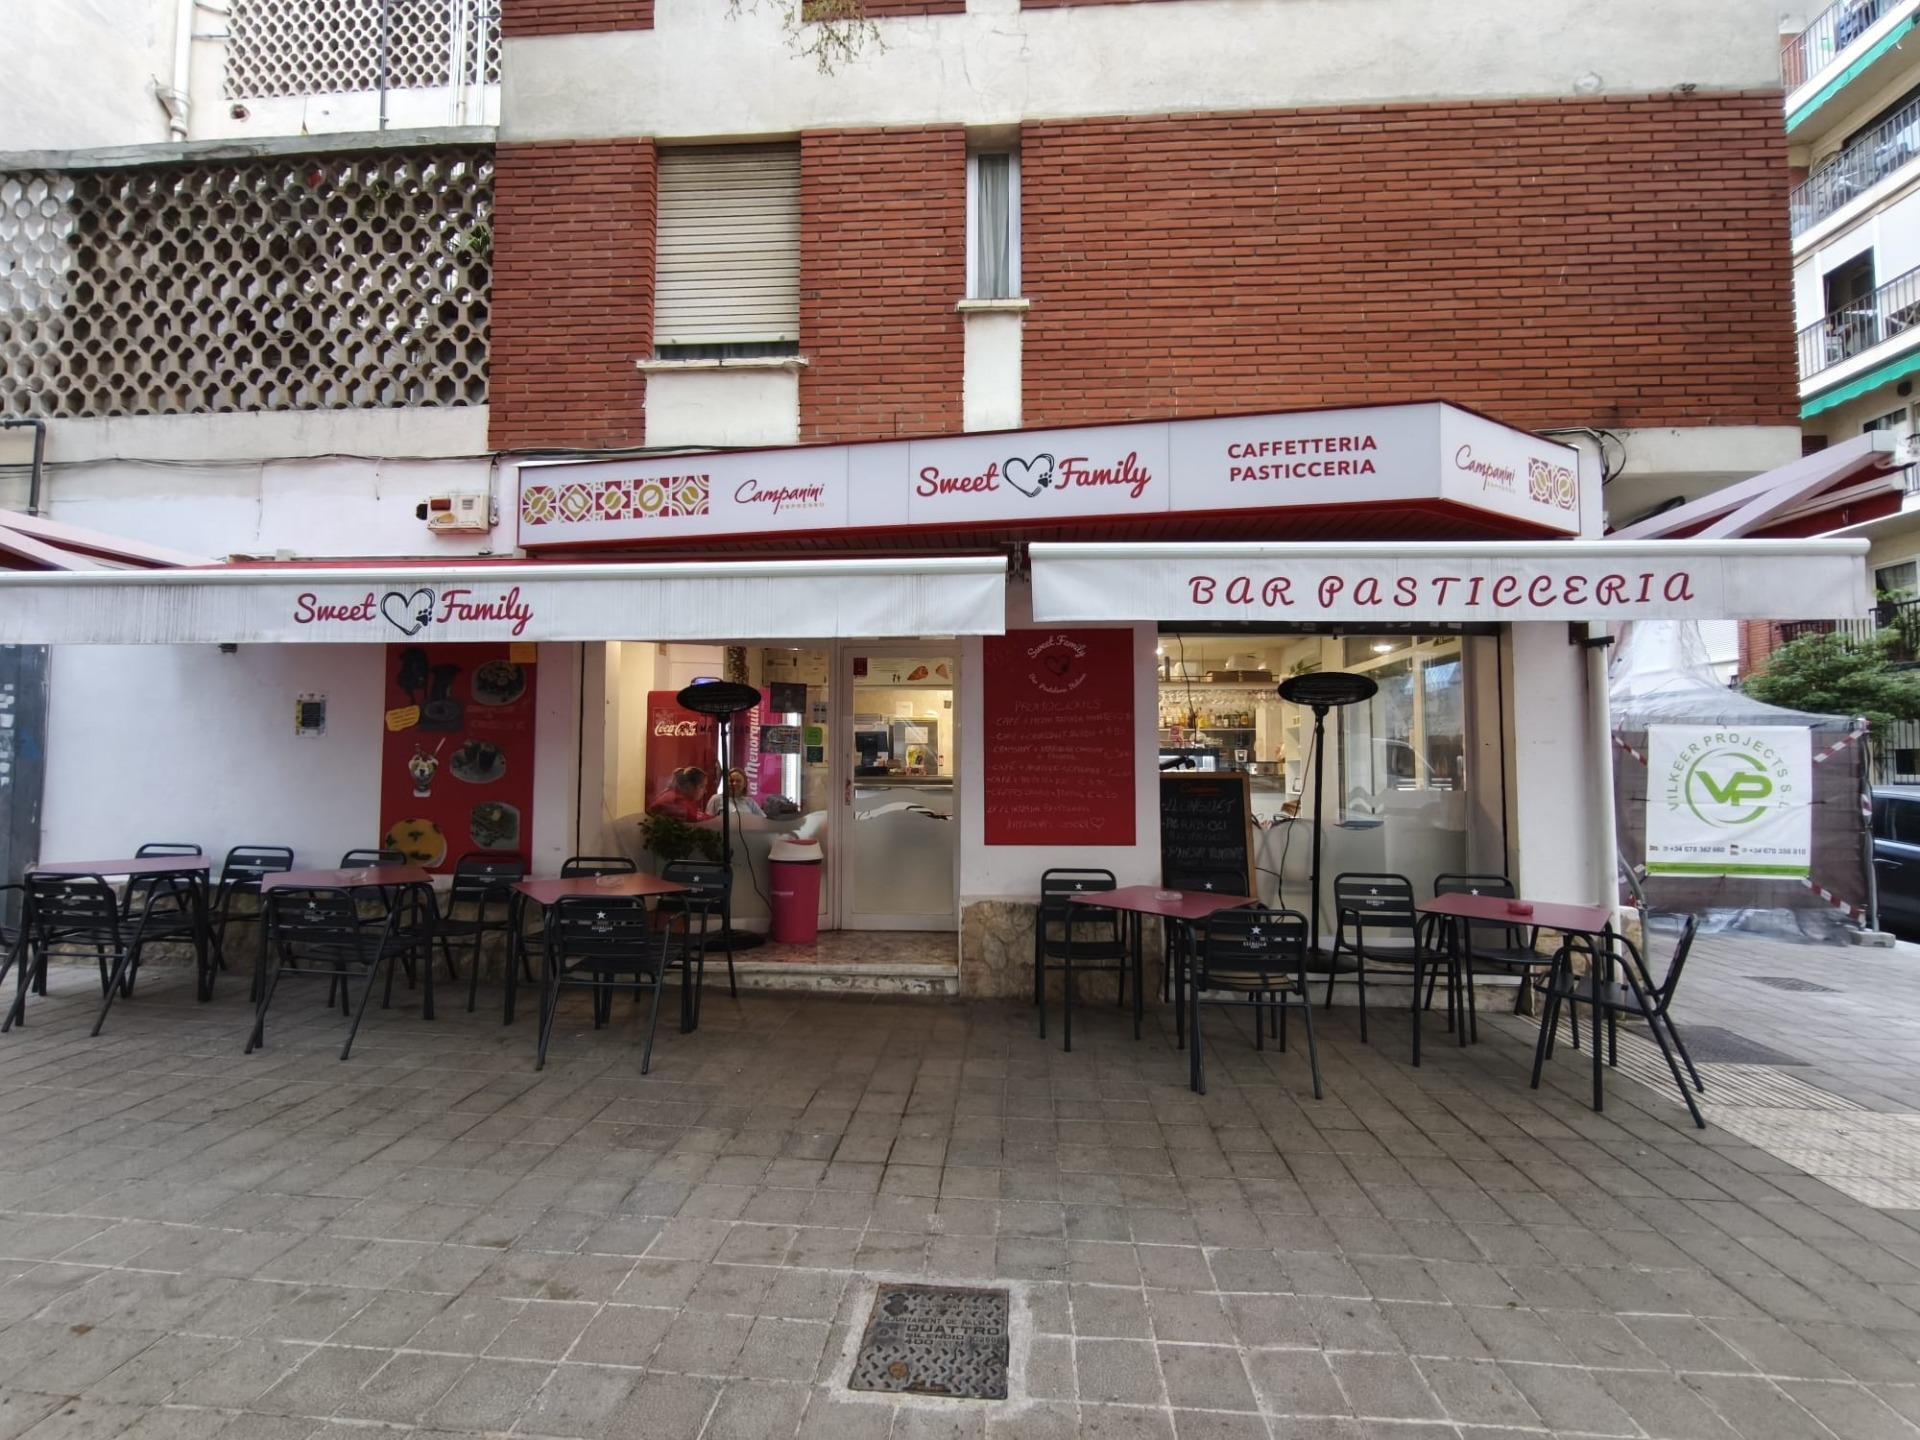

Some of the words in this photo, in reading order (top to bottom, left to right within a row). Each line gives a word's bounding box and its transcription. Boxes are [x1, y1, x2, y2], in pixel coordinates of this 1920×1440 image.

[1228, 435, 1377, 459] CAFFETTERIA
[1455, 444, 1516, 491] Campanini
[916, 462, 1000, 497] Sweet
[1055, 451, 1152, 499] Family
[1230, 459, 1376, 482] PASTICCERIA
[734, 479, 825, 515] Campanini
[294, 592, 376, 624] Sweet
[436, 586, 534, 636] Family
[1188, 575, 1295, 608] BAR
[1318, 572, 1694, 609] PASTICCERIA
[745, 704, 760, 778] Menorquin
[1667, 743, 1700, 811] VILKEER
[1703, 733, 1788, 778] PROJECTS
[906, 1324, 1000, 1336] QUATTRO
